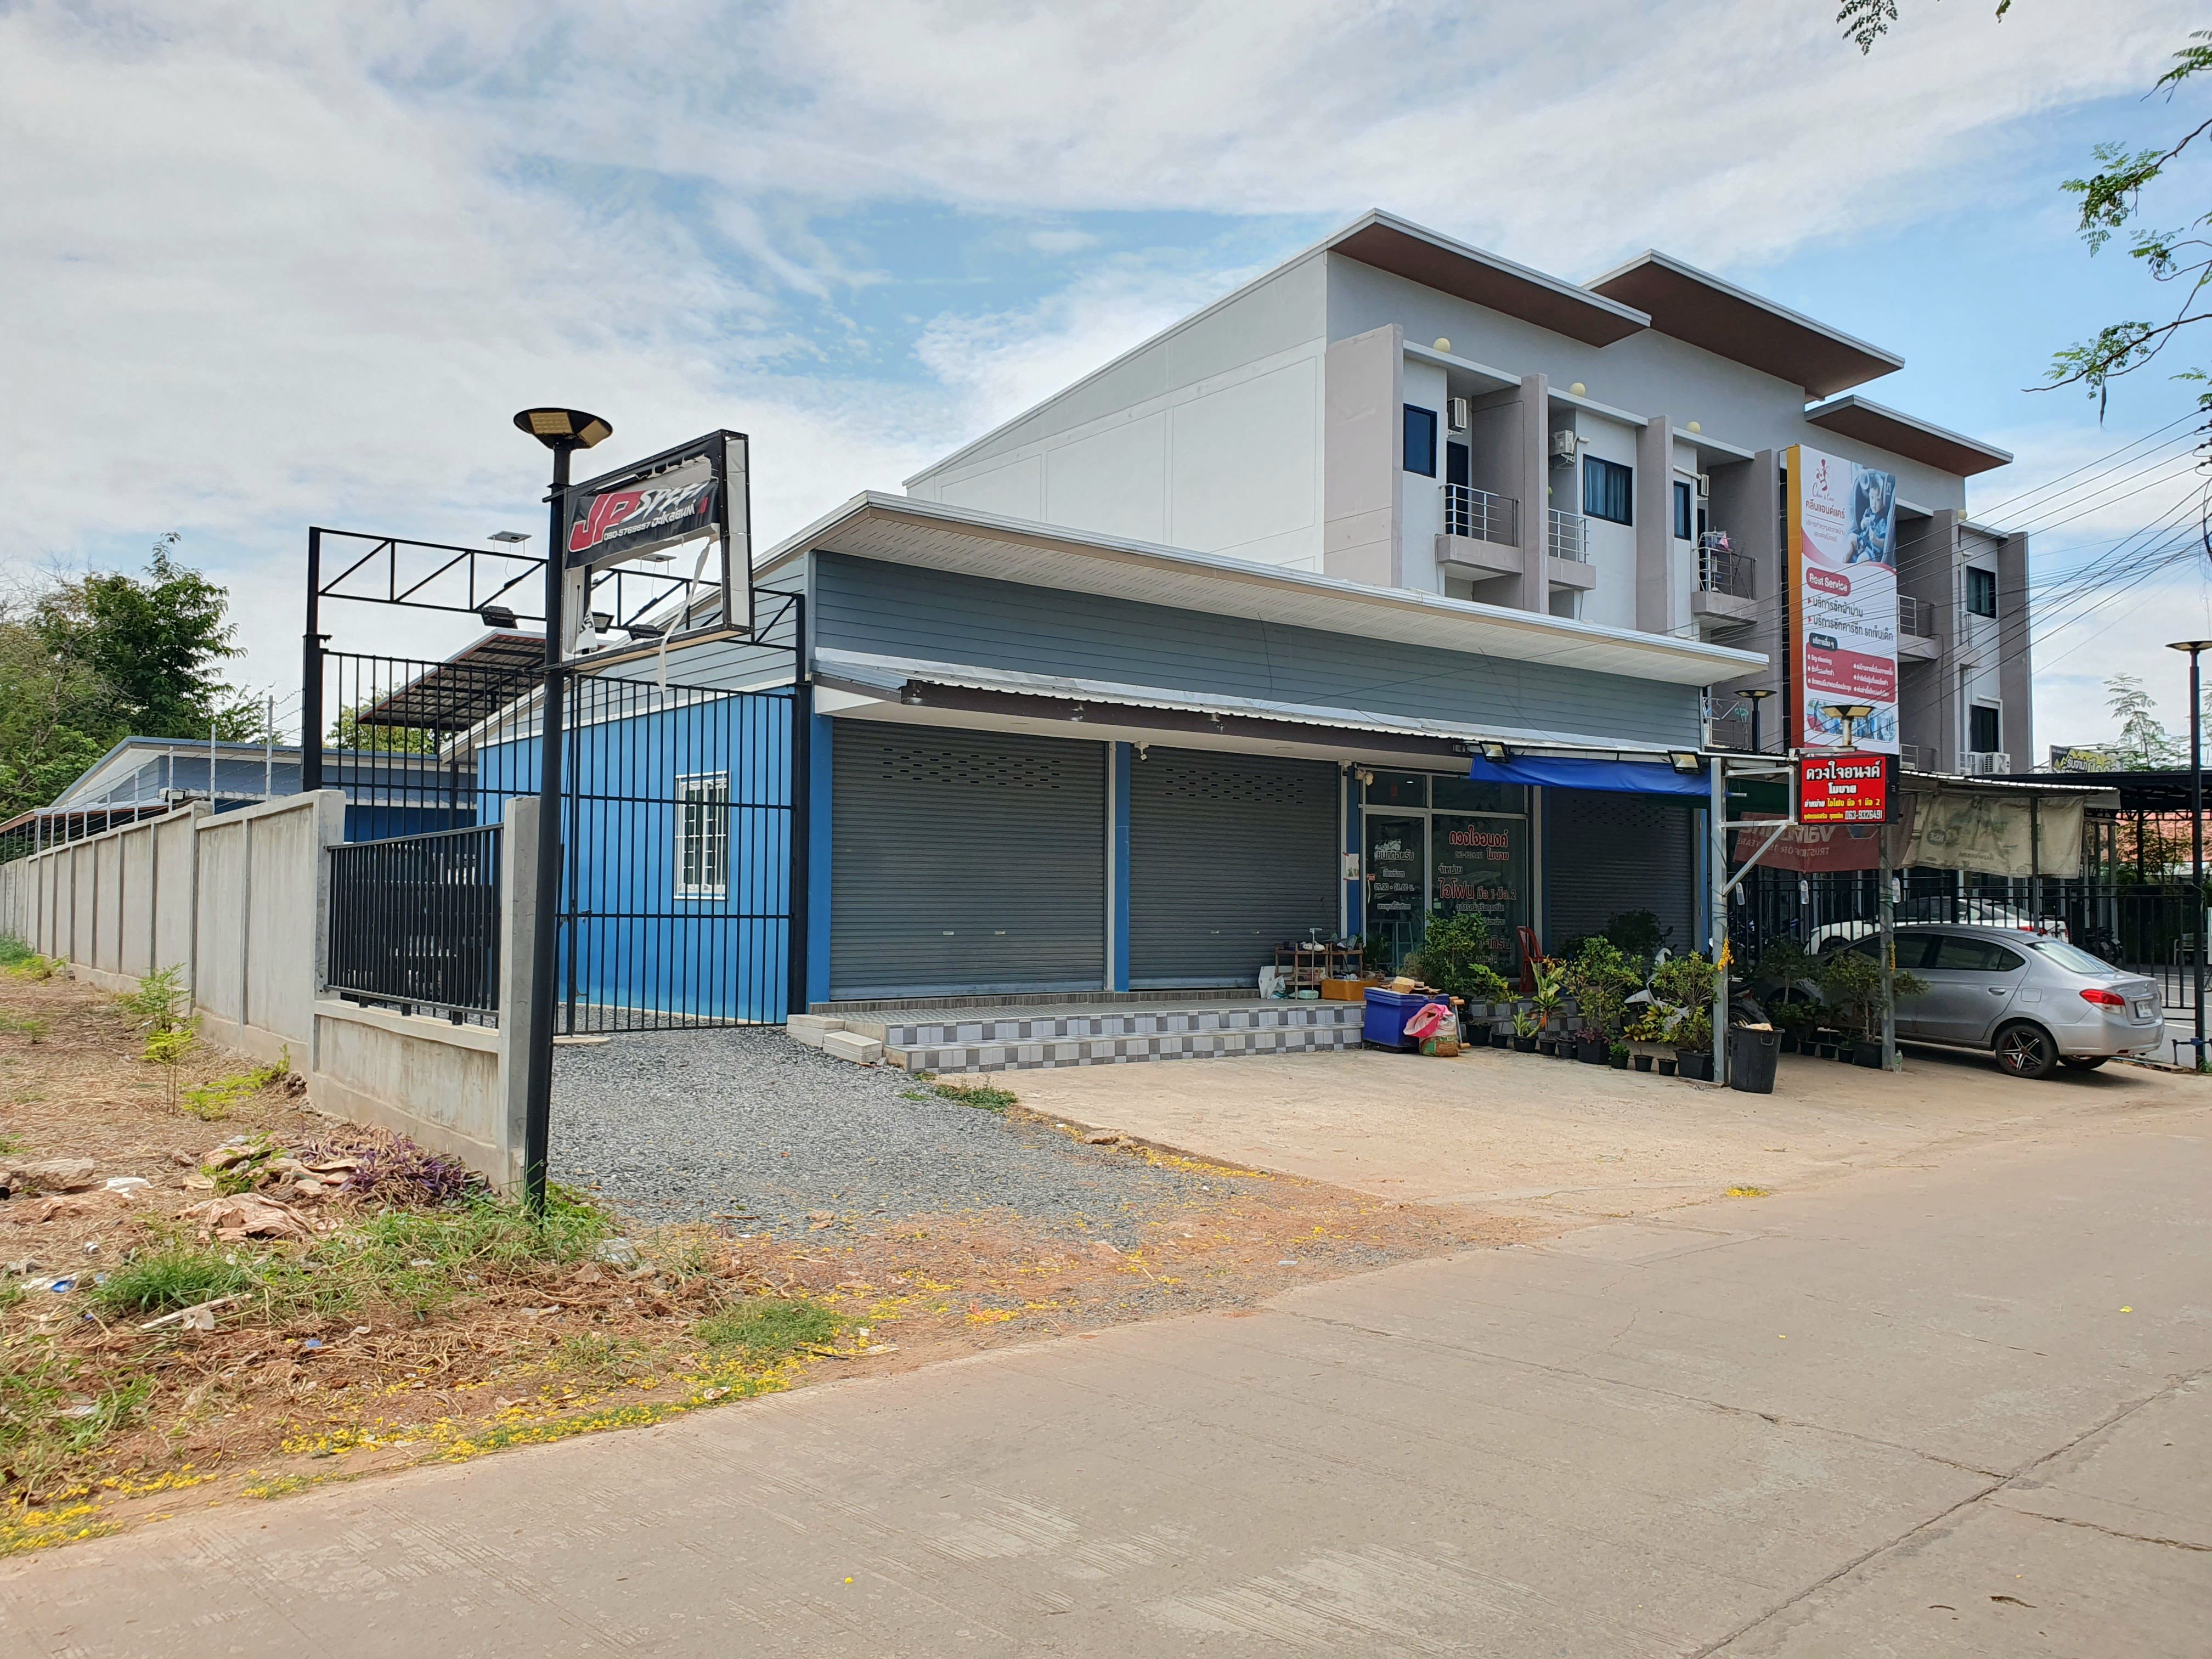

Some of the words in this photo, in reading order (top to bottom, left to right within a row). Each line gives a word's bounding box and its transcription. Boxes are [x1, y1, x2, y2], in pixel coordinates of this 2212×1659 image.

[1805, 499, 1845, 519] คลีนแอนด์แคร์
[1809, 573, 1824, 586] Best
[1825, 577, 1848, 592] Service
[1806, 760, 1881, 781] ดวงใจอนงค์
[2067, 757, 2088, 771] รับจำนำ
[1827, 782, 1857, 794] โมบาย
[1844, 810, 1883, 820] 063-9326491
[1449, 825, 1509, 848] ดวงใจอนงค์
[1377, 848, 1415, 861] ยินดีต้อนรับ
[1486, 847, 1509, 860] โมบาย
[1438, 862, 1463, 874] จำหน่าย
[1438, 877, 1475, 899] ไอโฟน
[1476, 885, 1489, 900] มือ
[1497, 886, 1509, 900] มือ
[1511, 889, 1517, 900] 2
